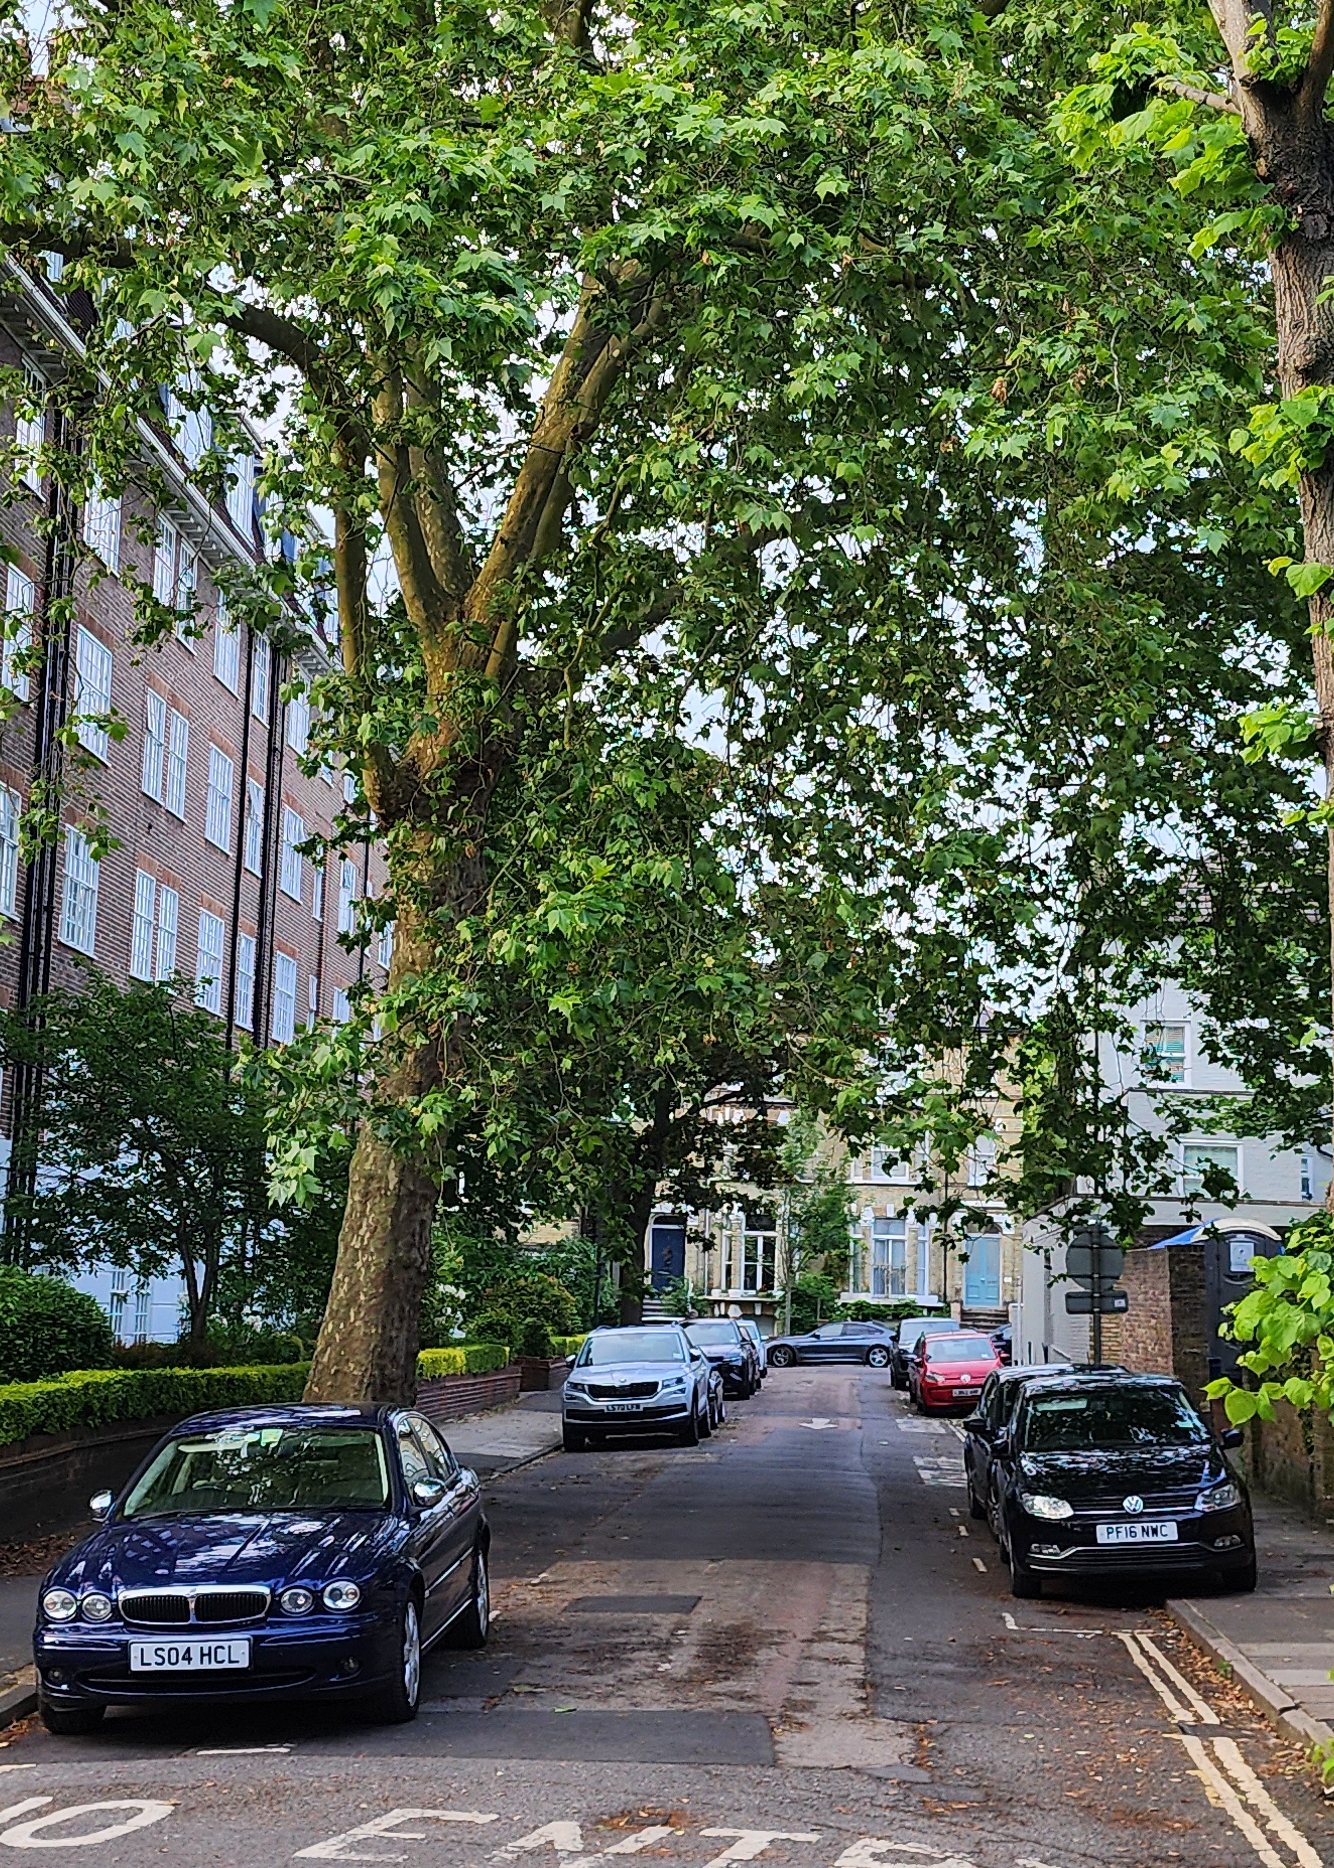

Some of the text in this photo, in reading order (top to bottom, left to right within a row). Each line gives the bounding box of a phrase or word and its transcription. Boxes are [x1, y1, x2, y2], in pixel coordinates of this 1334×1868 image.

[1106, 1524, 1168, 1540] PF16 NWC
[140, 1644, 240, 1667] LS04 HCL
